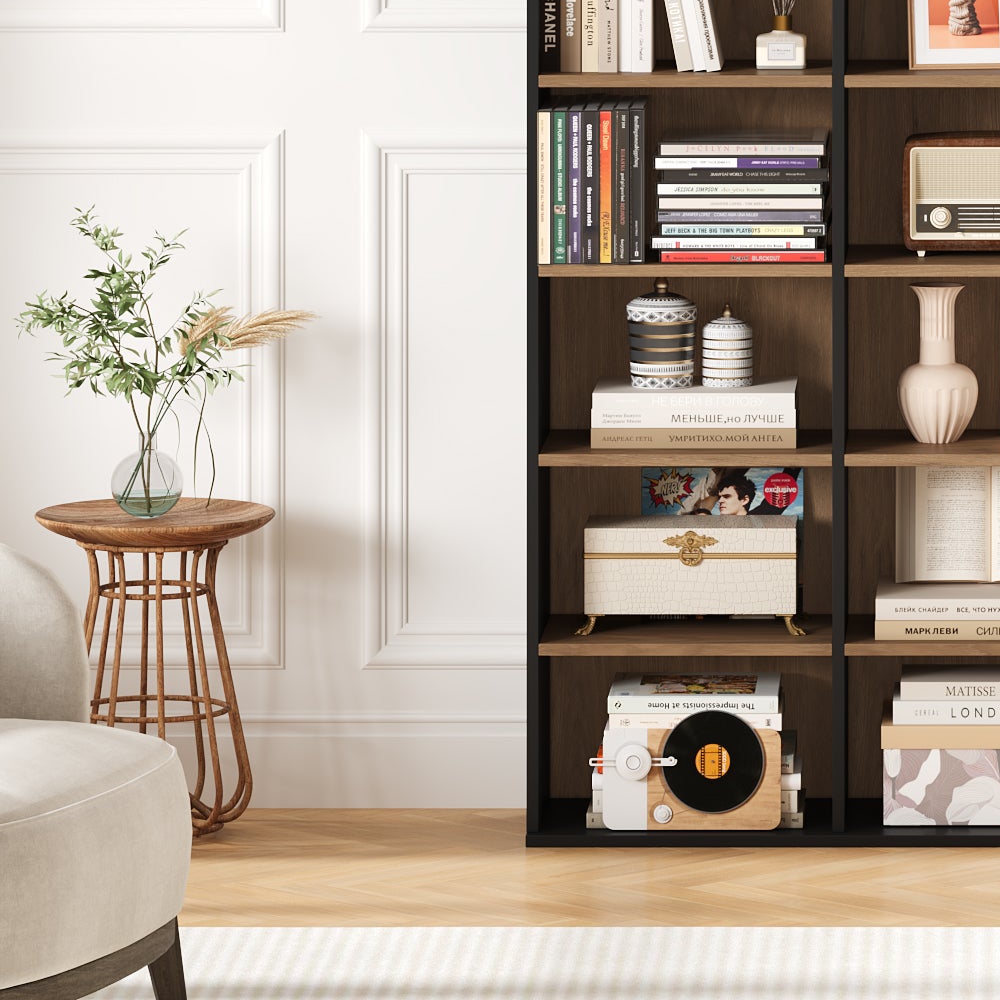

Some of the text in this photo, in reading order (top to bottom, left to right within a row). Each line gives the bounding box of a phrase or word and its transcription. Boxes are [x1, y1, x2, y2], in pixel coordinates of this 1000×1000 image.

[566, 0, 576, 37] lovelace
[743, 414, 785, 424] ЛУЧШЕ
[752, 434, 783, 442] АНГЕЛ
[918, 606, 949, 614] СНАЙДЕР
[905, 627, 931, 635] МАРК
[932, 627, 959, 635] ЛЕВИ
[945, 686, 996, 697] MATISSE
[647, 701, 755, 710] The Impressionists at Home
[914, 709, 940, 717] CEREAL
